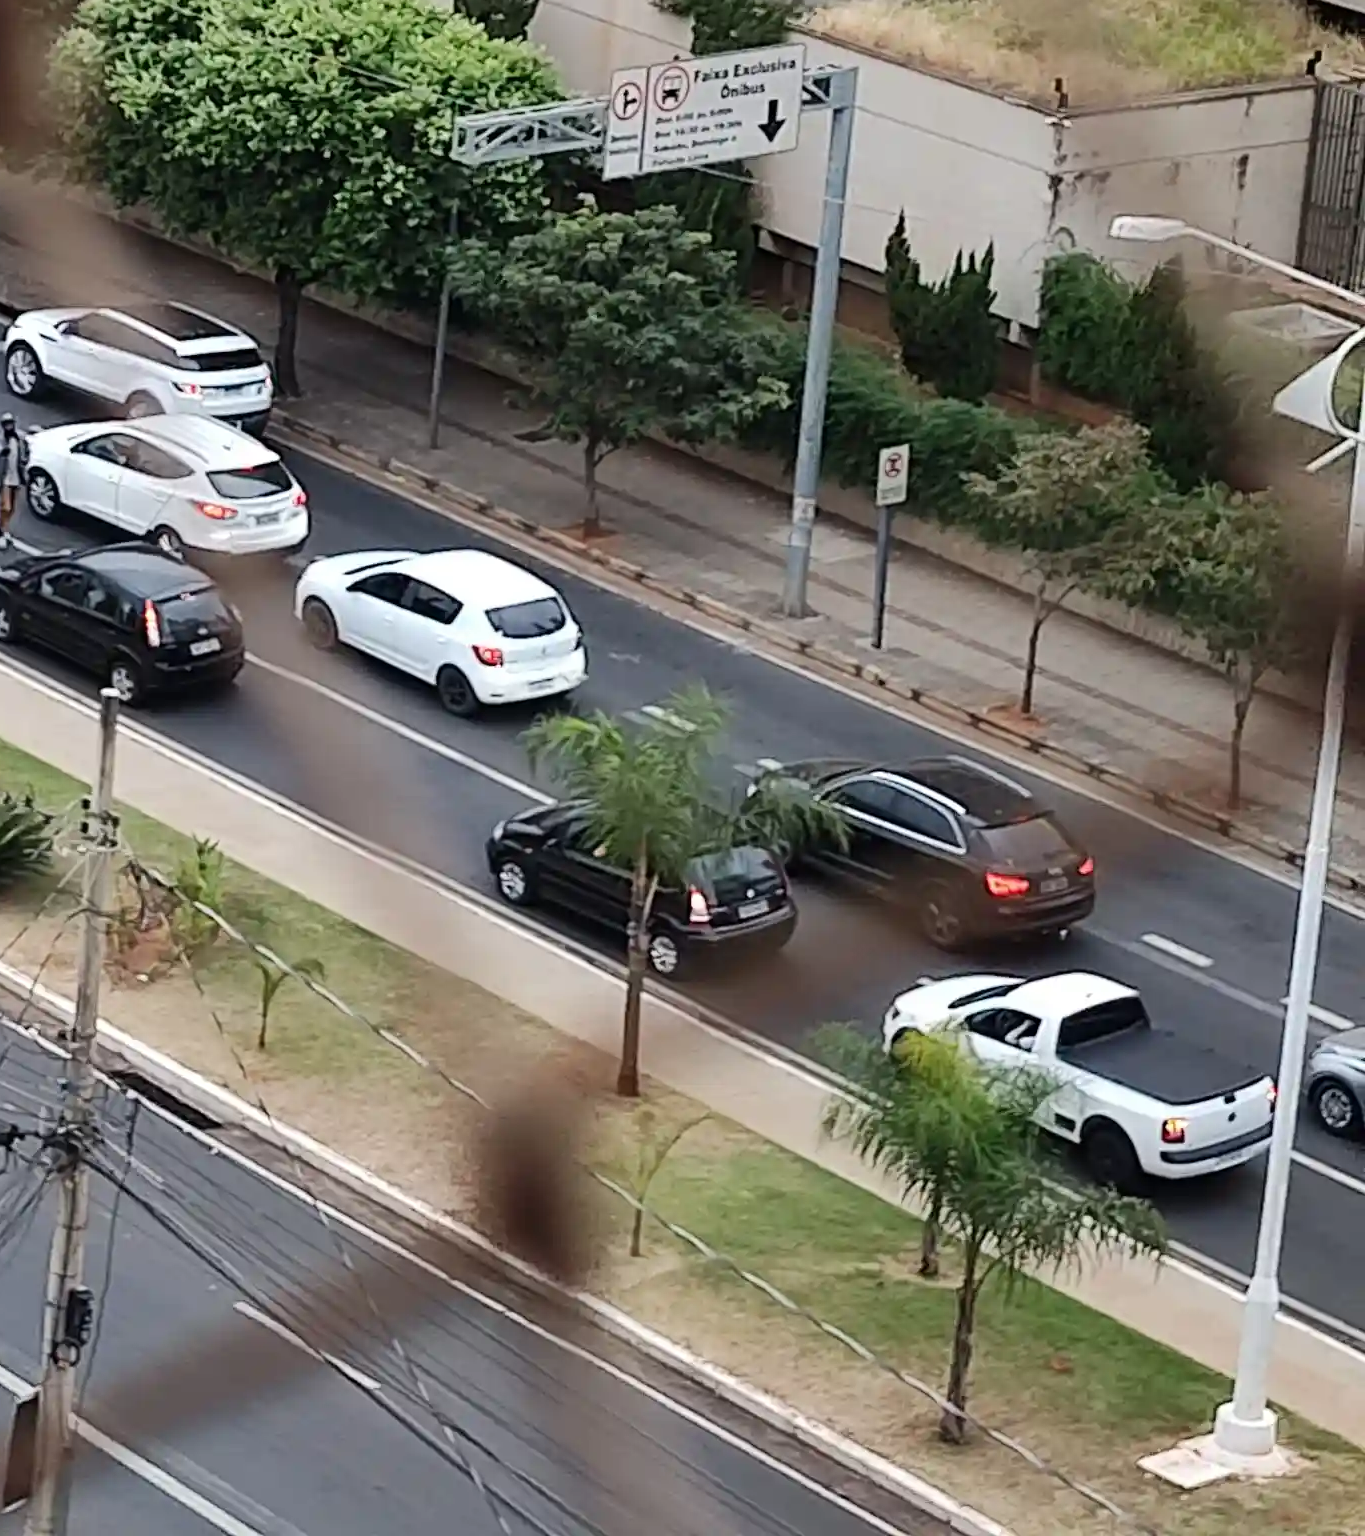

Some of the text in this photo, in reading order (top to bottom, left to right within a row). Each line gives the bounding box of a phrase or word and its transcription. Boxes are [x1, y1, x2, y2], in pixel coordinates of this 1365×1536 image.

[694, 57, 797, 85] Faixa Exclusiva
[720, 82, 766, 100] Ônibus
